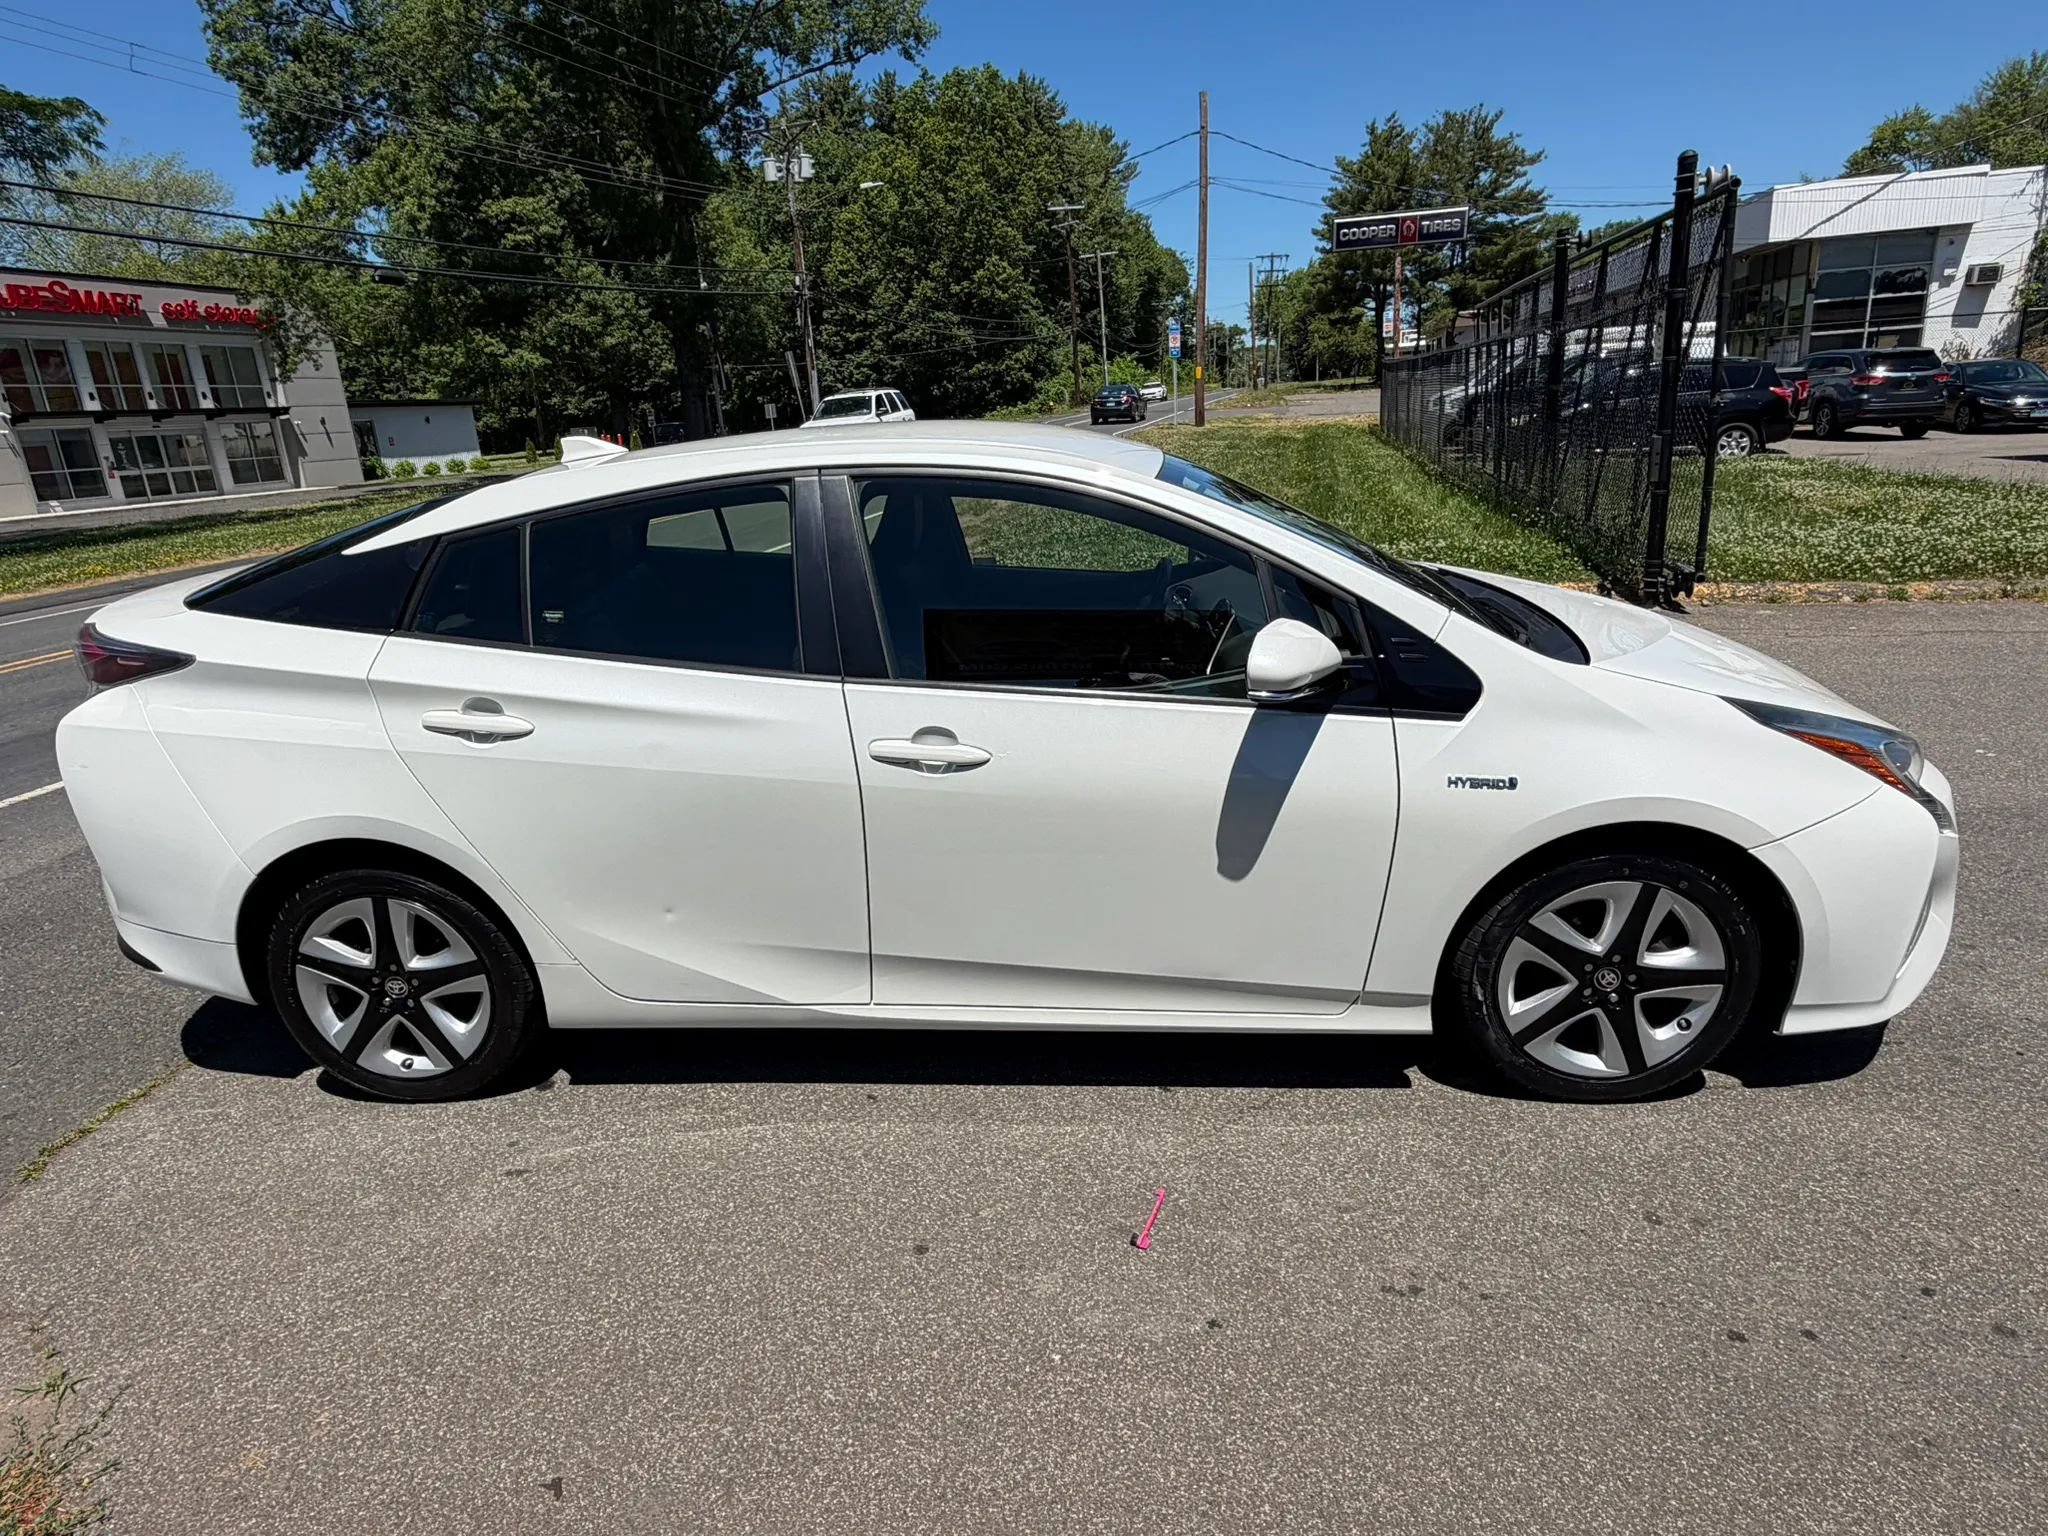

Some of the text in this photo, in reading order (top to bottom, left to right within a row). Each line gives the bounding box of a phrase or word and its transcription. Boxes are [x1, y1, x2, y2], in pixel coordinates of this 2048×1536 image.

[1339, 218, 1462, 241] COOPER TIRES
[161, 299, 200, 320] self
[204, 303, 278, 331] storag
[1447, 776, 1507, 790] HYBRID
